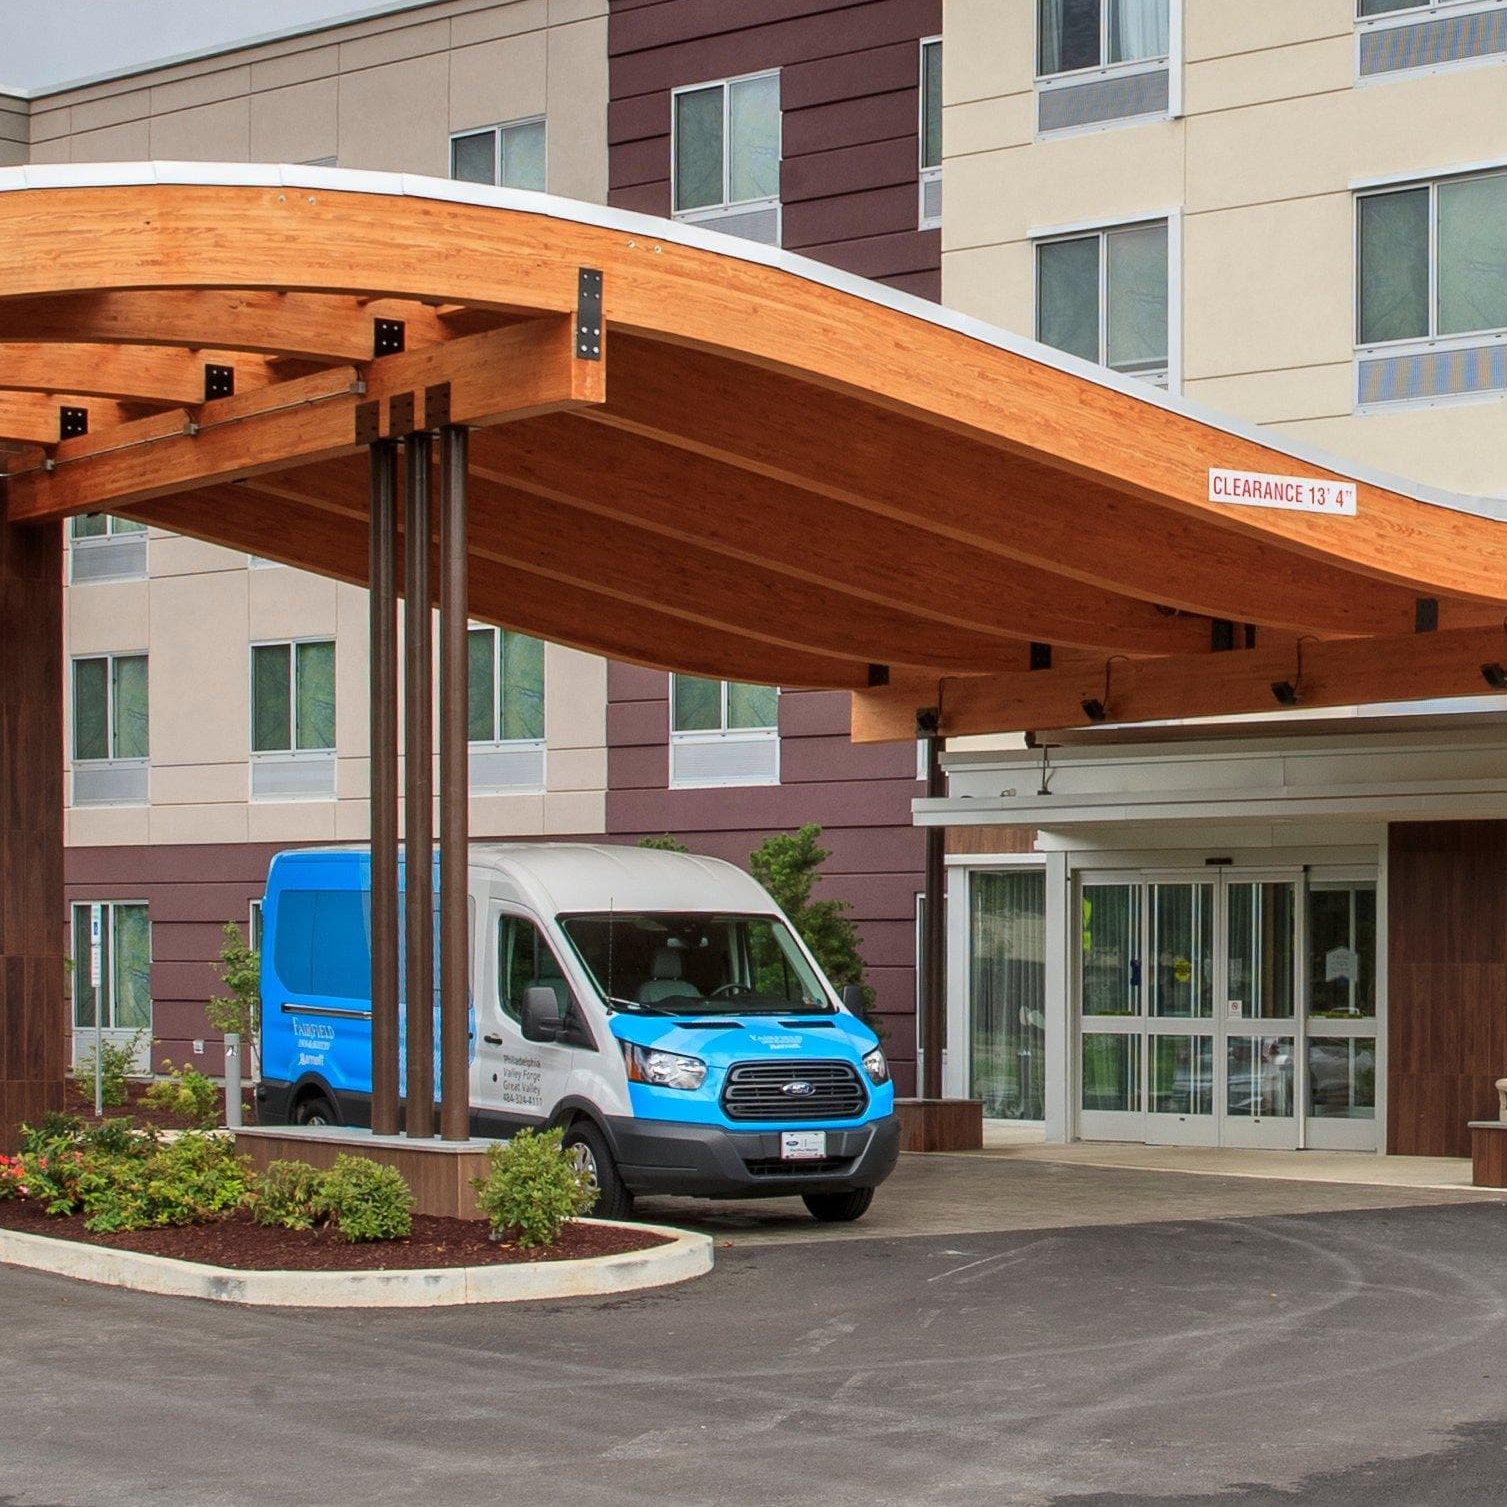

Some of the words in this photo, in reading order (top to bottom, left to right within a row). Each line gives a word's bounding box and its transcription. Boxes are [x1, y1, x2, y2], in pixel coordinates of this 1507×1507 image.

[1213, 476, 1302, 503] CLEARANCE
[1308, 486, 1331, 505] 13'
[503, 1067, 521, 1081] Valley
[523, 1069, 541, 1083] Forge
[503, 1080, 520, 1092] Great
[521, 1082, 540, 1096] Valley
